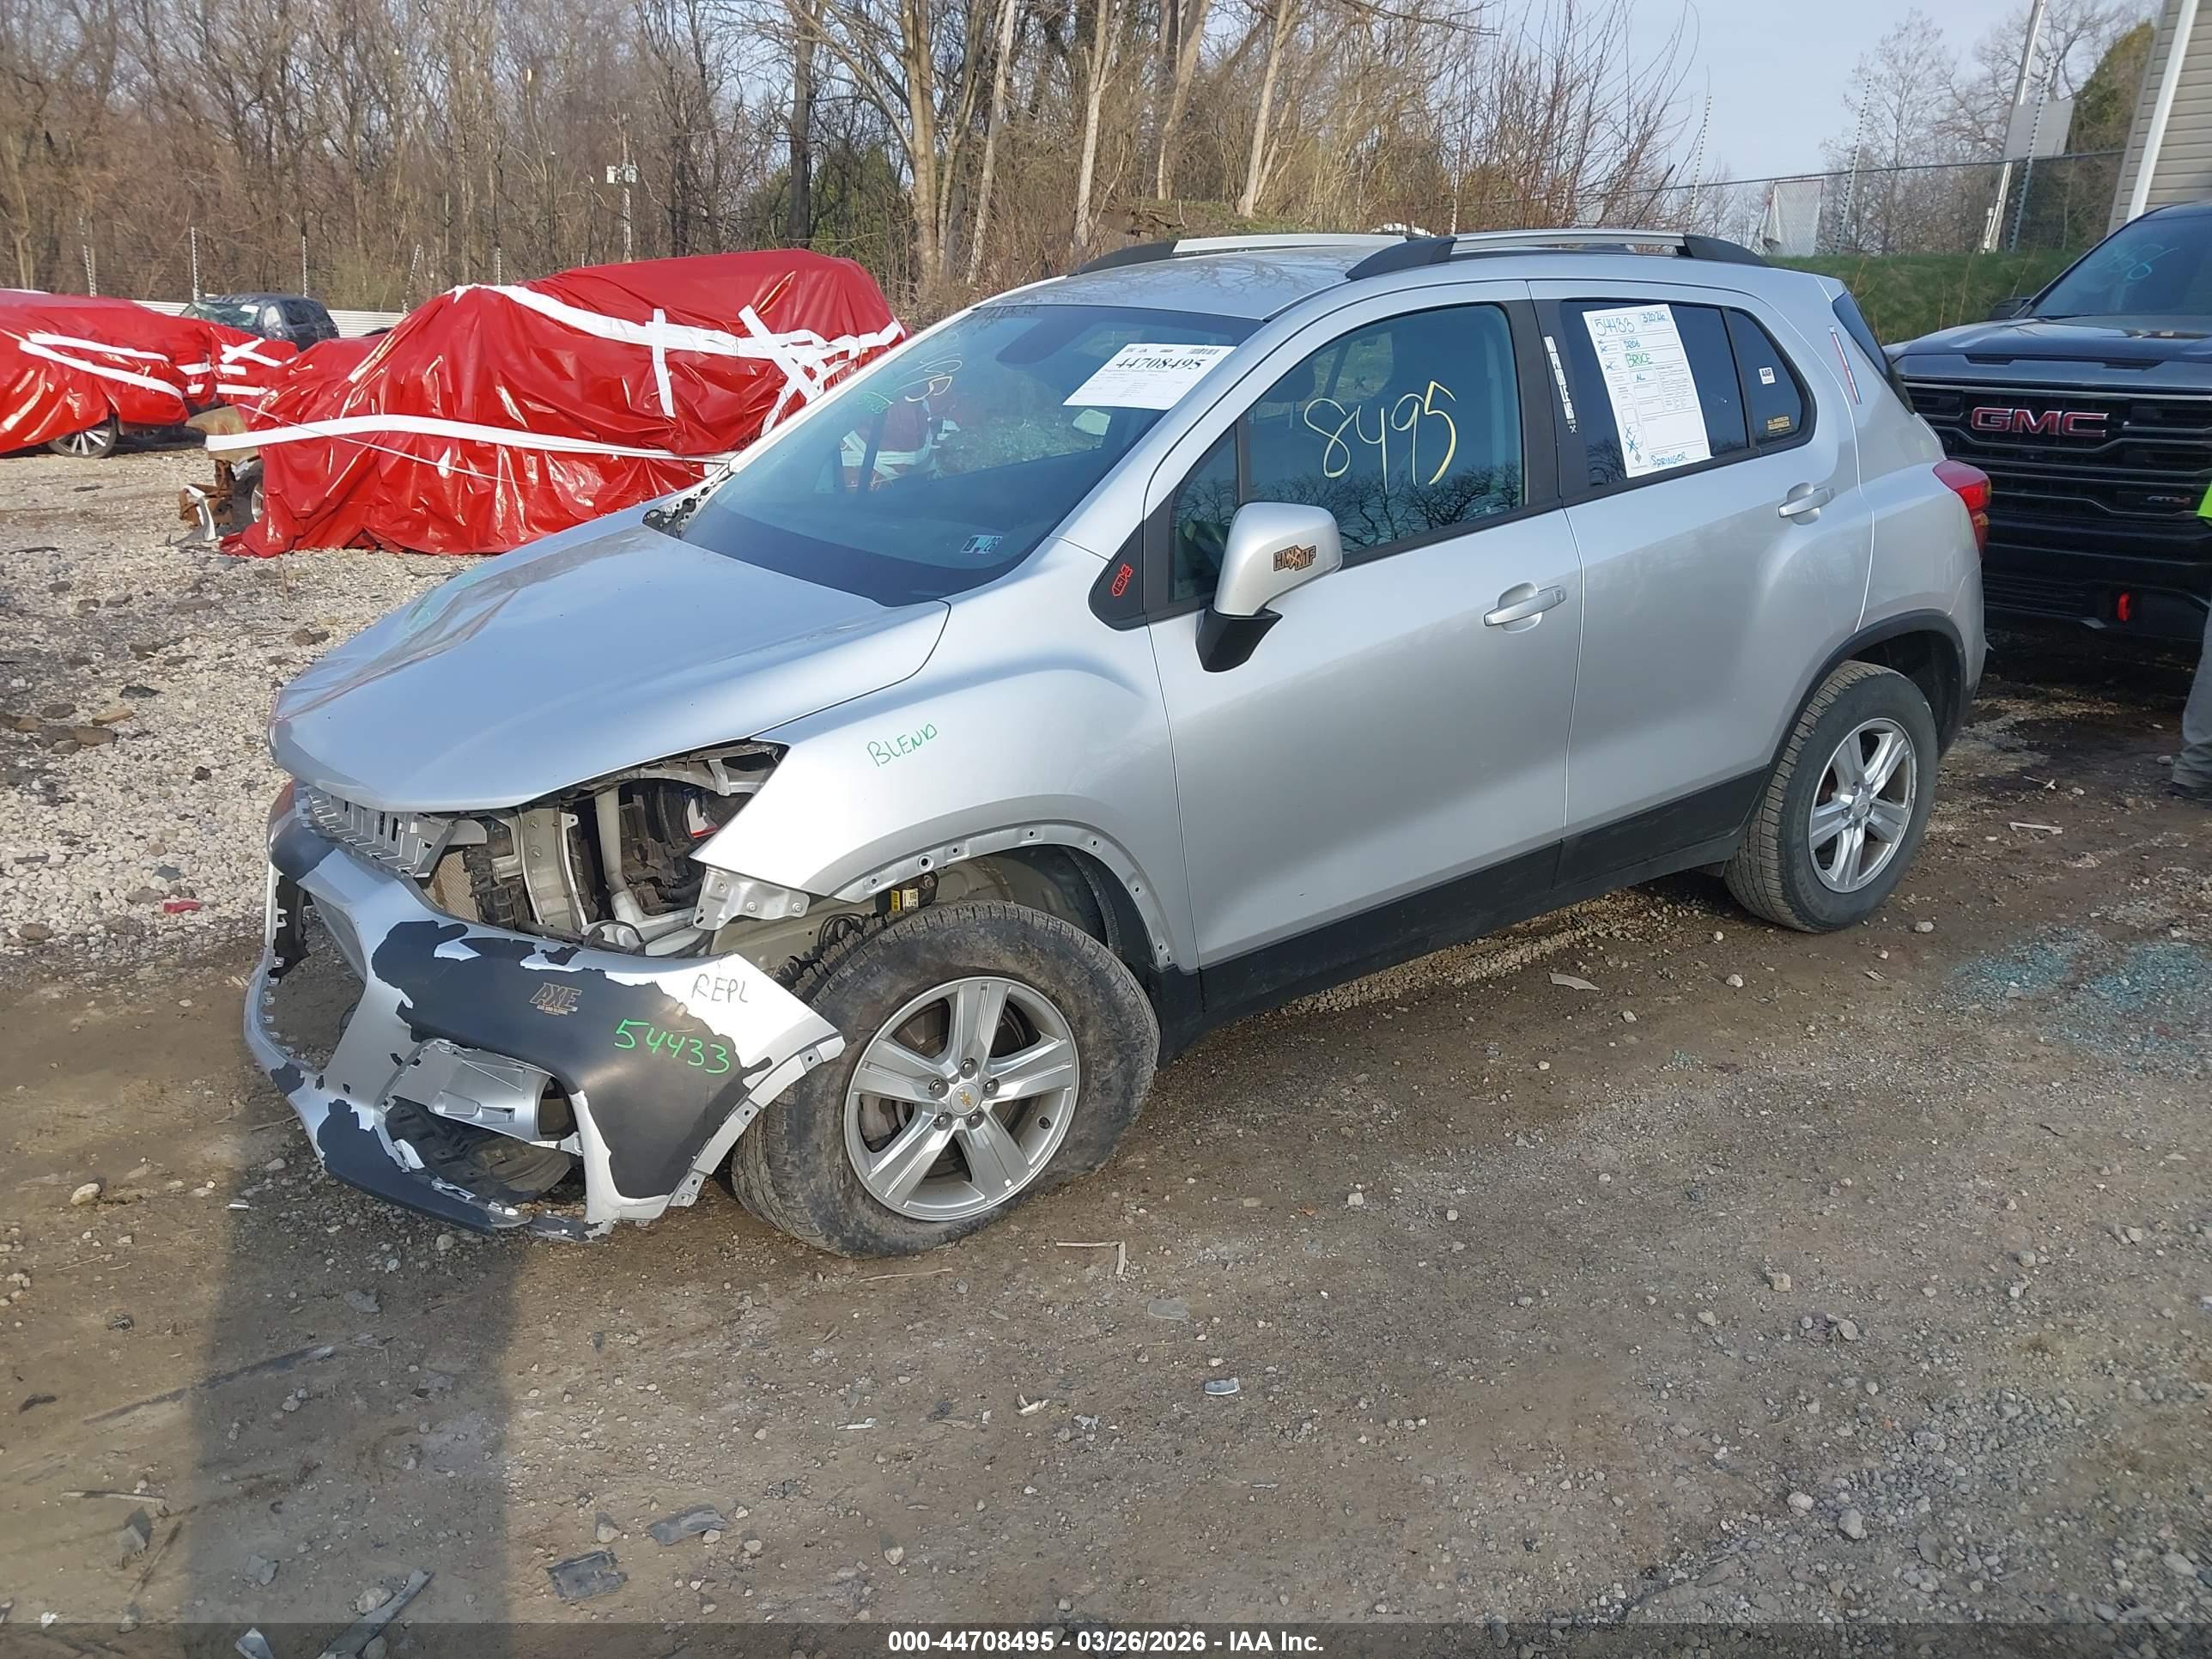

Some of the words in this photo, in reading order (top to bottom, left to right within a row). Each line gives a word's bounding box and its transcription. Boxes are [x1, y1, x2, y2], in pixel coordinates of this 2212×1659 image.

[1595, 317, 1635, 336] 54433
[1116, 357, 1208, 370] 44708495
[1304, 380, 1457, 495] 8495
[1971, 406, 2110, 438] GMC
[866, 723, 938, 767] BLEND
[529, 982, 583, 1012] AXE
[692, 973, 749, 1003] REPL
[614, 1018, 731, 1075] 54433
